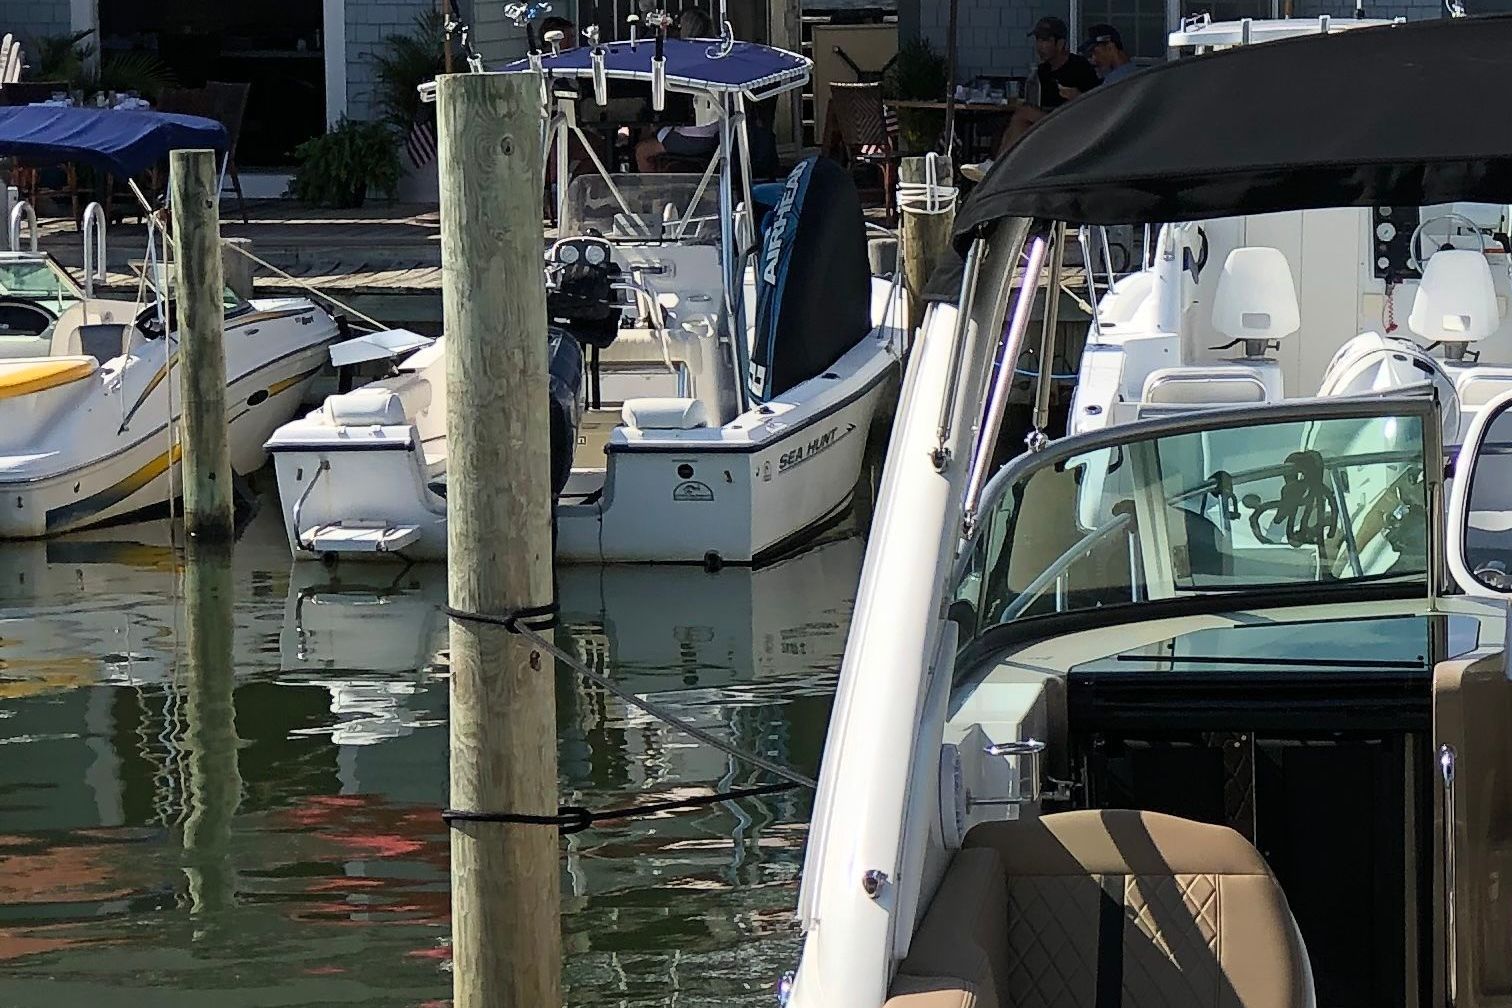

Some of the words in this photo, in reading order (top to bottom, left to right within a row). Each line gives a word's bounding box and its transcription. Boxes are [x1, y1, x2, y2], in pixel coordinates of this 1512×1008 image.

[763, 159, 808, 286] AIRHEAD
[779, 446, 804, 469] SEA
[806, 426, 839, 456] HUNT
